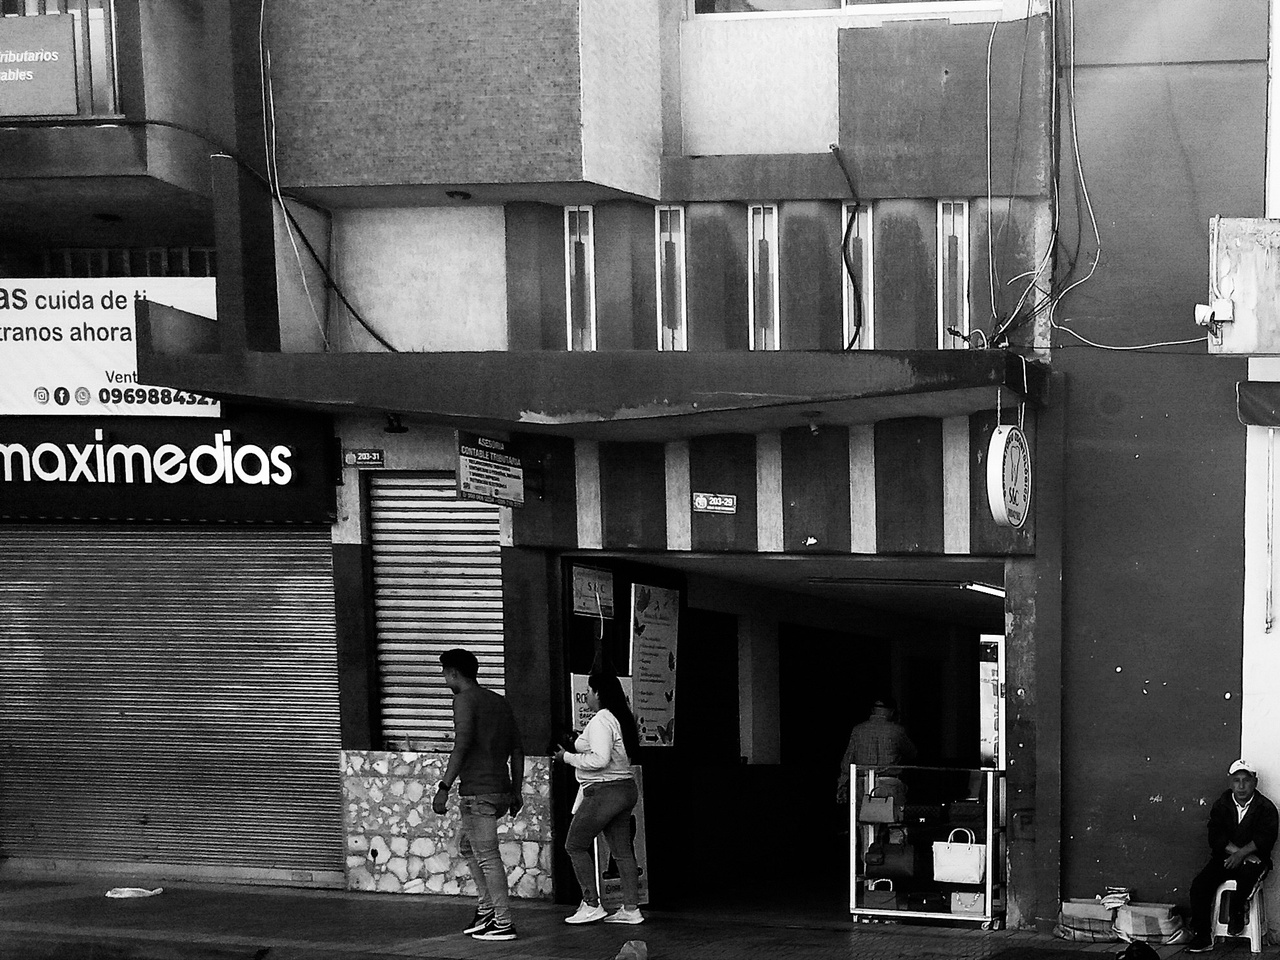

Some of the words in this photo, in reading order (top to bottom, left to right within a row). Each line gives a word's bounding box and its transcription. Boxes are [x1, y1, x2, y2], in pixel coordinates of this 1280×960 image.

[35, 290, 94, 310] cuida
[100, 290, 128, 310] de
[70, 322, 133, 342] ahora
[708, 496, 733, 507] 203-29
